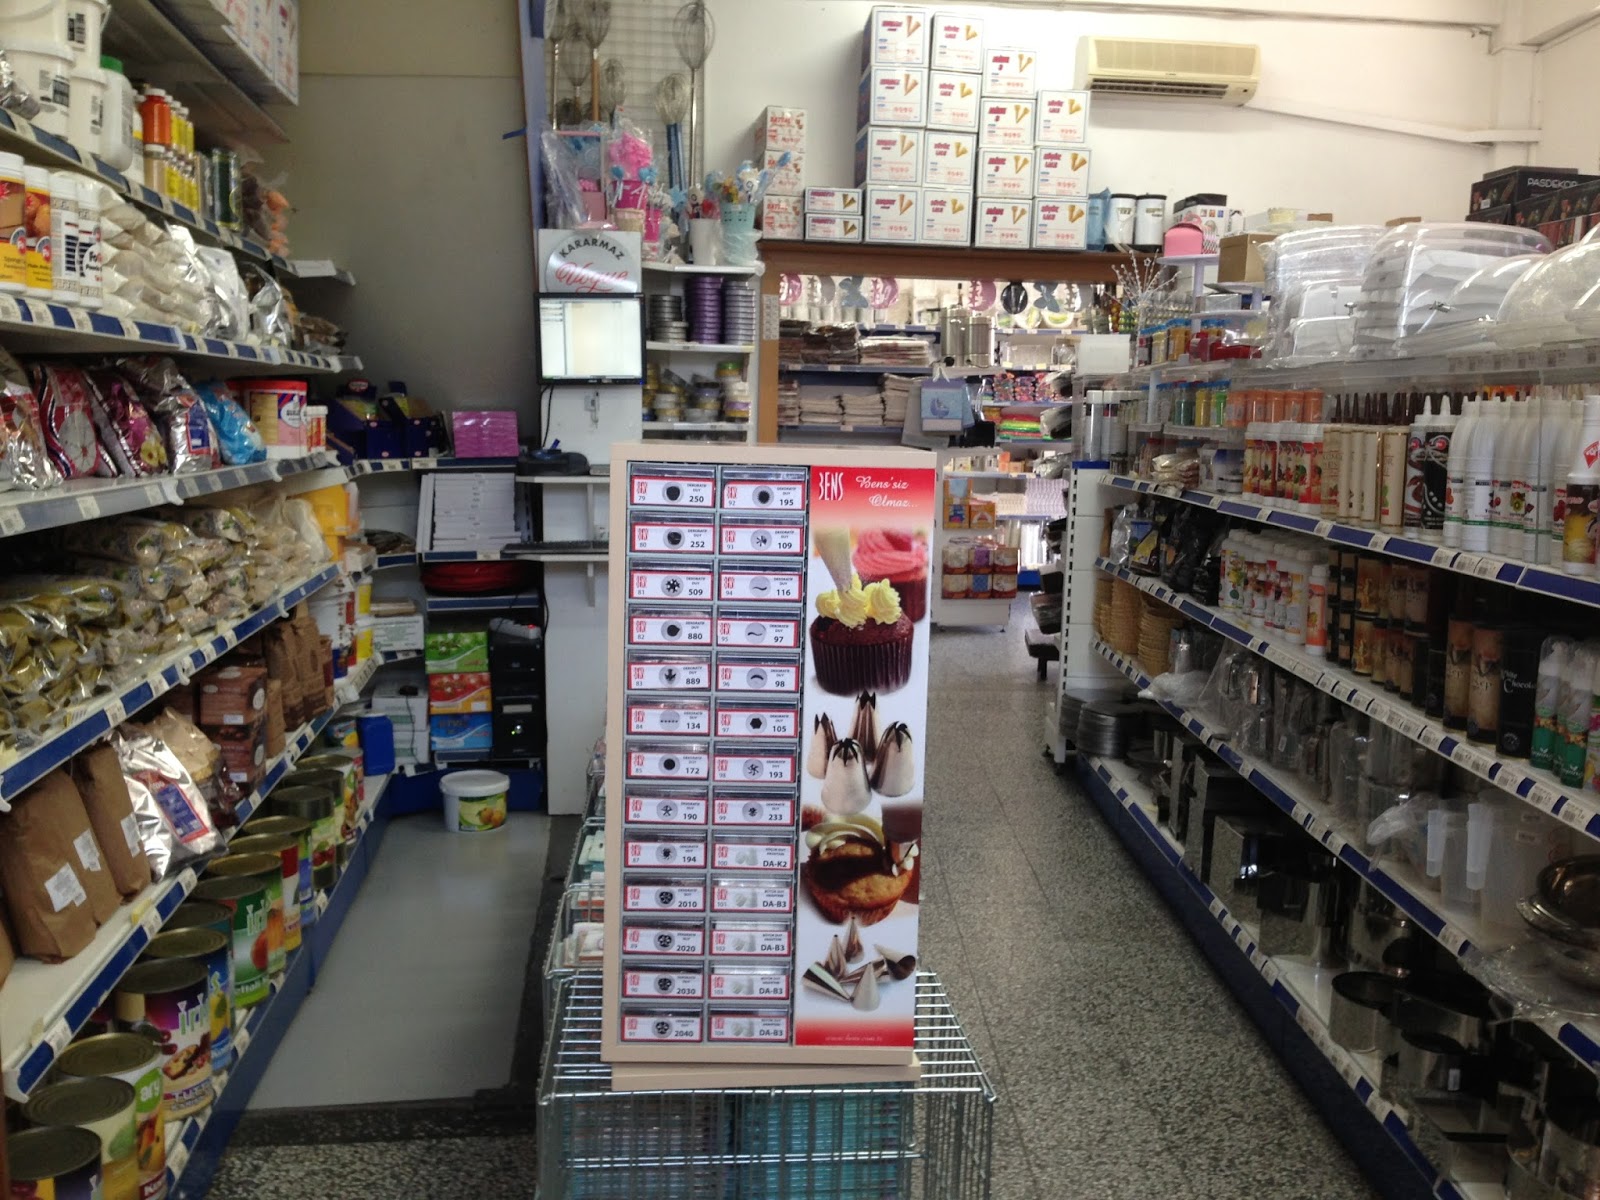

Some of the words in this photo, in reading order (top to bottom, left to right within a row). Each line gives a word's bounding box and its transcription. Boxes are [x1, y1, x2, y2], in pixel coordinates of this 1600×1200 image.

[558, 238, 625, 261] KARARMAZ
[818, 472, 844, 501] BENS
[856, 476, 910, 490] Bens'siz
